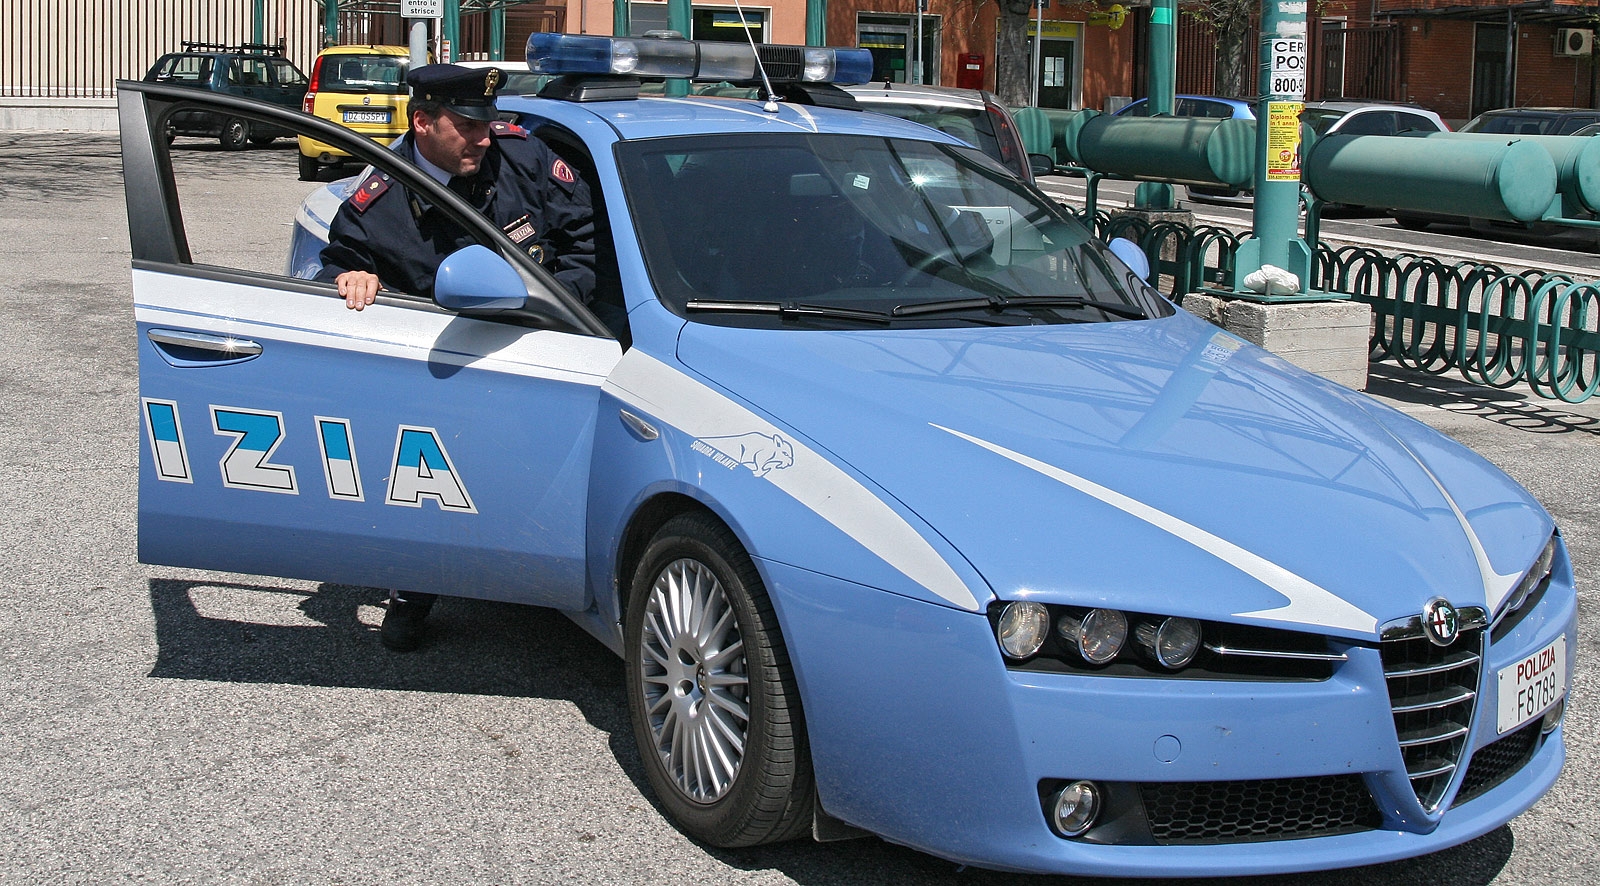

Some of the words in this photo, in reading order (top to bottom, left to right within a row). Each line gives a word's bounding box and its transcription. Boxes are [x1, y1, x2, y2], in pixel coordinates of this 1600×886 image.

[1275, 56, 1305, 70] POS
[348, 111, 358, 120] DZ
[141, 397, 479, 515] IZIA
[690, 440, 716, 458] SQUADRA
[711, 451, 740, 471] VOLANTE
[1517, 646, 1556, 685] POLIZIA
[1517, 671, 1556, 722] F8789
